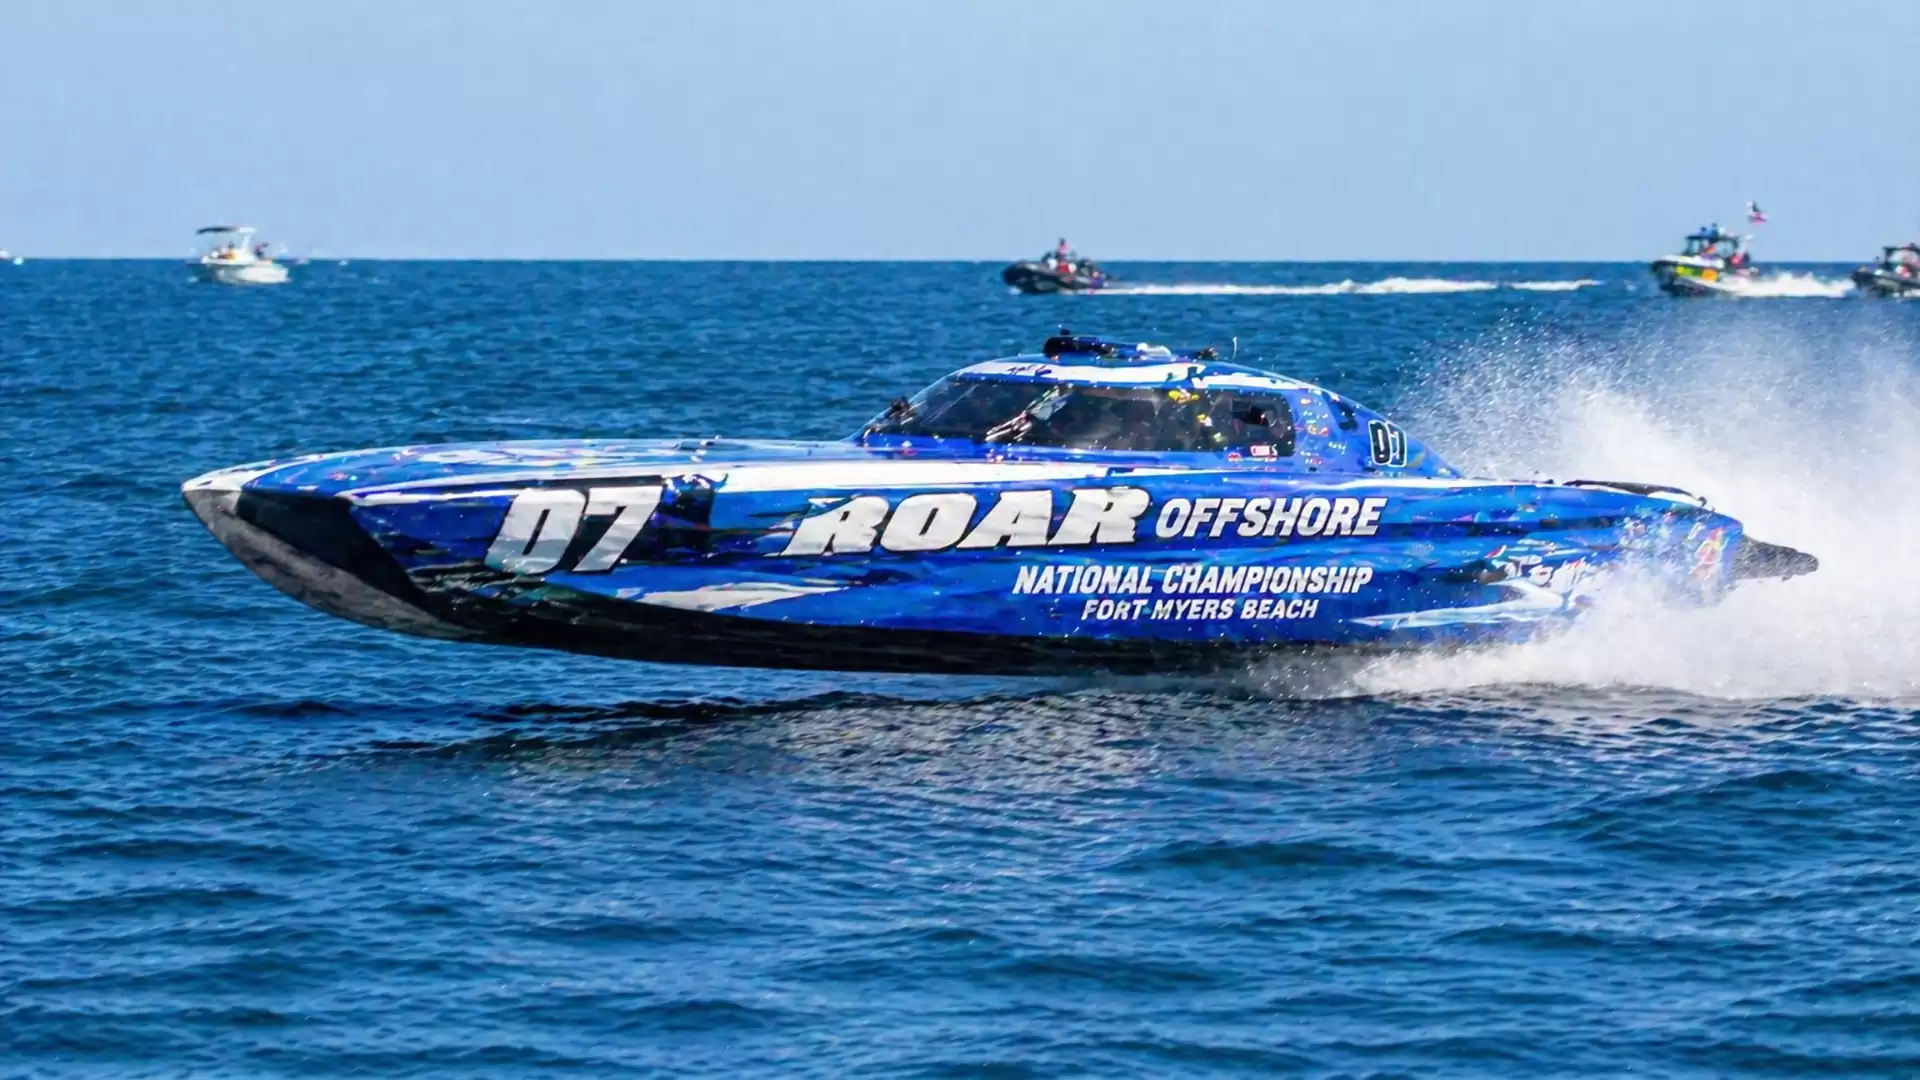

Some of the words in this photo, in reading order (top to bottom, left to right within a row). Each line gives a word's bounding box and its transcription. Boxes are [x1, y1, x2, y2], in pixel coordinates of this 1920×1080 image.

[484, 483, 663, 575] 07
[779, 486, 1150, 556] ROAR
[1155, 497, 1387, 539] OFFSHORE
[1012, 565, 1153, 595] NATIONAL
[1160, 565, 1373, 594] CHAMPIONSHIP
[1081, 600, 1146, 621] FORT
[1150, 600, 1234, 620] MYERS
[1240, 599, 1318, 620] BEACH
